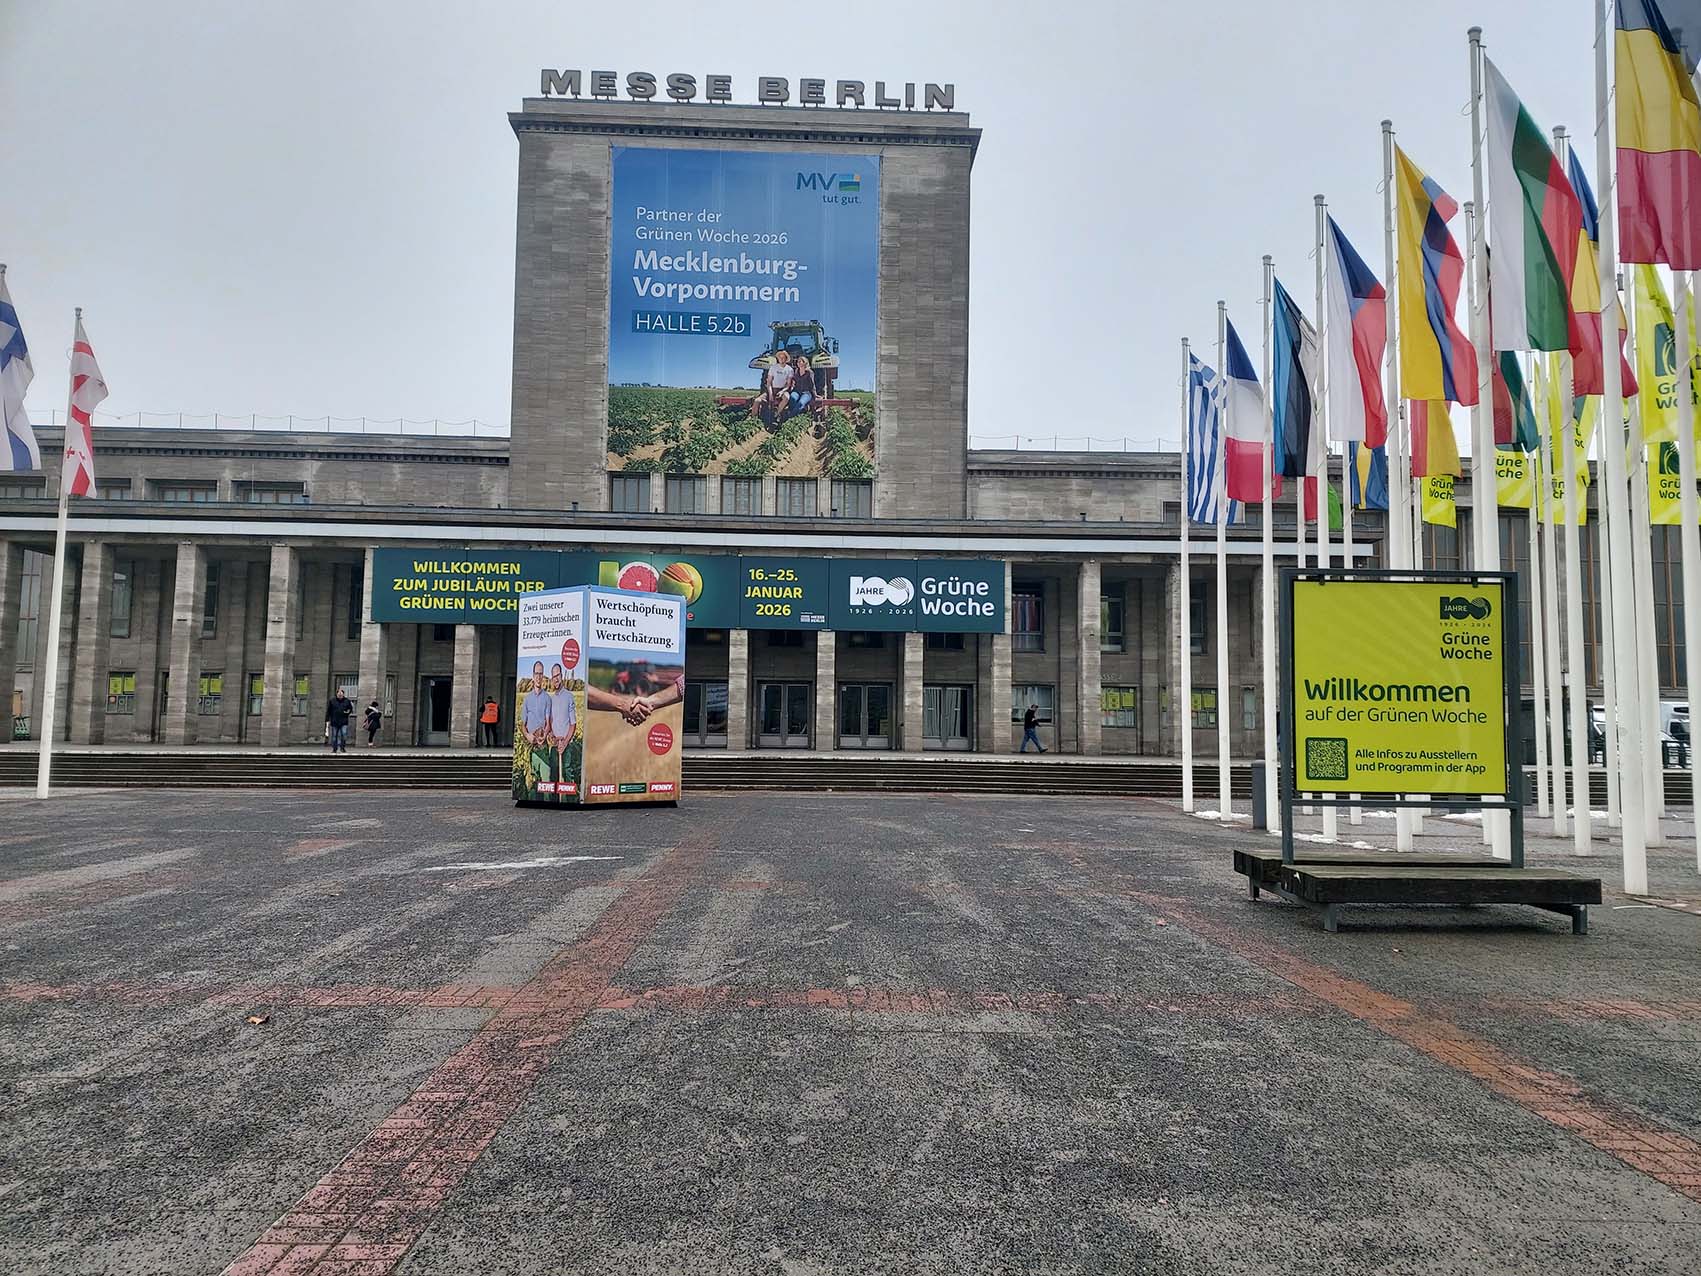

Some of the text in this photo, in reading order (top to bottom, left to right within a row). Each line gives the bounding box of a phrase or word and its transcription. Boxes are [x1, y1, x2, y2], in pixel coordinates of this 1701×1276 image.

[541, 69, 955, 109] MESSE BERLIN
[796, 173, 837, 191] MV
[823, 194, 862, 206] tut gut.
[636, 206, 722, 223] Partner der
[635, 226, 788, 245] Grünen Woche 2026
[633, 249, 808, 281] Mecklenburg-
[633, 276, 800, 303] Vorpommern
[636, 313, 745, 334] HALLE 5.2b
[413, 560, 521, 575] WILLKOMMEN
[393, 577, 545, 593] ZUM JUBILÄUM DER
[745, 586, 803, 599] JANUAR
[856, 587, 884, 596] JAHRE
[921, 576, 989, 596] Grüne
[400, 594, 518, 611] GRÜNEN WOCH
[523, 602, 564, 612] Zwei unserer
[596, 599, 674, 619] Wertschöpfung
[755, 603, 792, 616] 2026
[921, 598, 995, 616] Woche
[543, 612, 580, 624] heimischen
[596, 613, 636, 627] braucht
[596, 629, 674, 649] Wertschätzung.
[1442, 632, 1490, 645] Grüne
[1440, 647, 1493, 660] Woche
[1304, 677, 1470, 703] Willkommen
[1305, 706, 1488, 724] auf der Grünen Woche
[1355, 749, 1374, 759] Alle
[1376, 749, 1402, 759] Infos
[1419, 751, 1478, 760] Ausstellern
[1355, 763, 1486, 775] und Programm in der App
[537, 783, 555, 792] REWE
[590, 785, 615, 794] REWE
